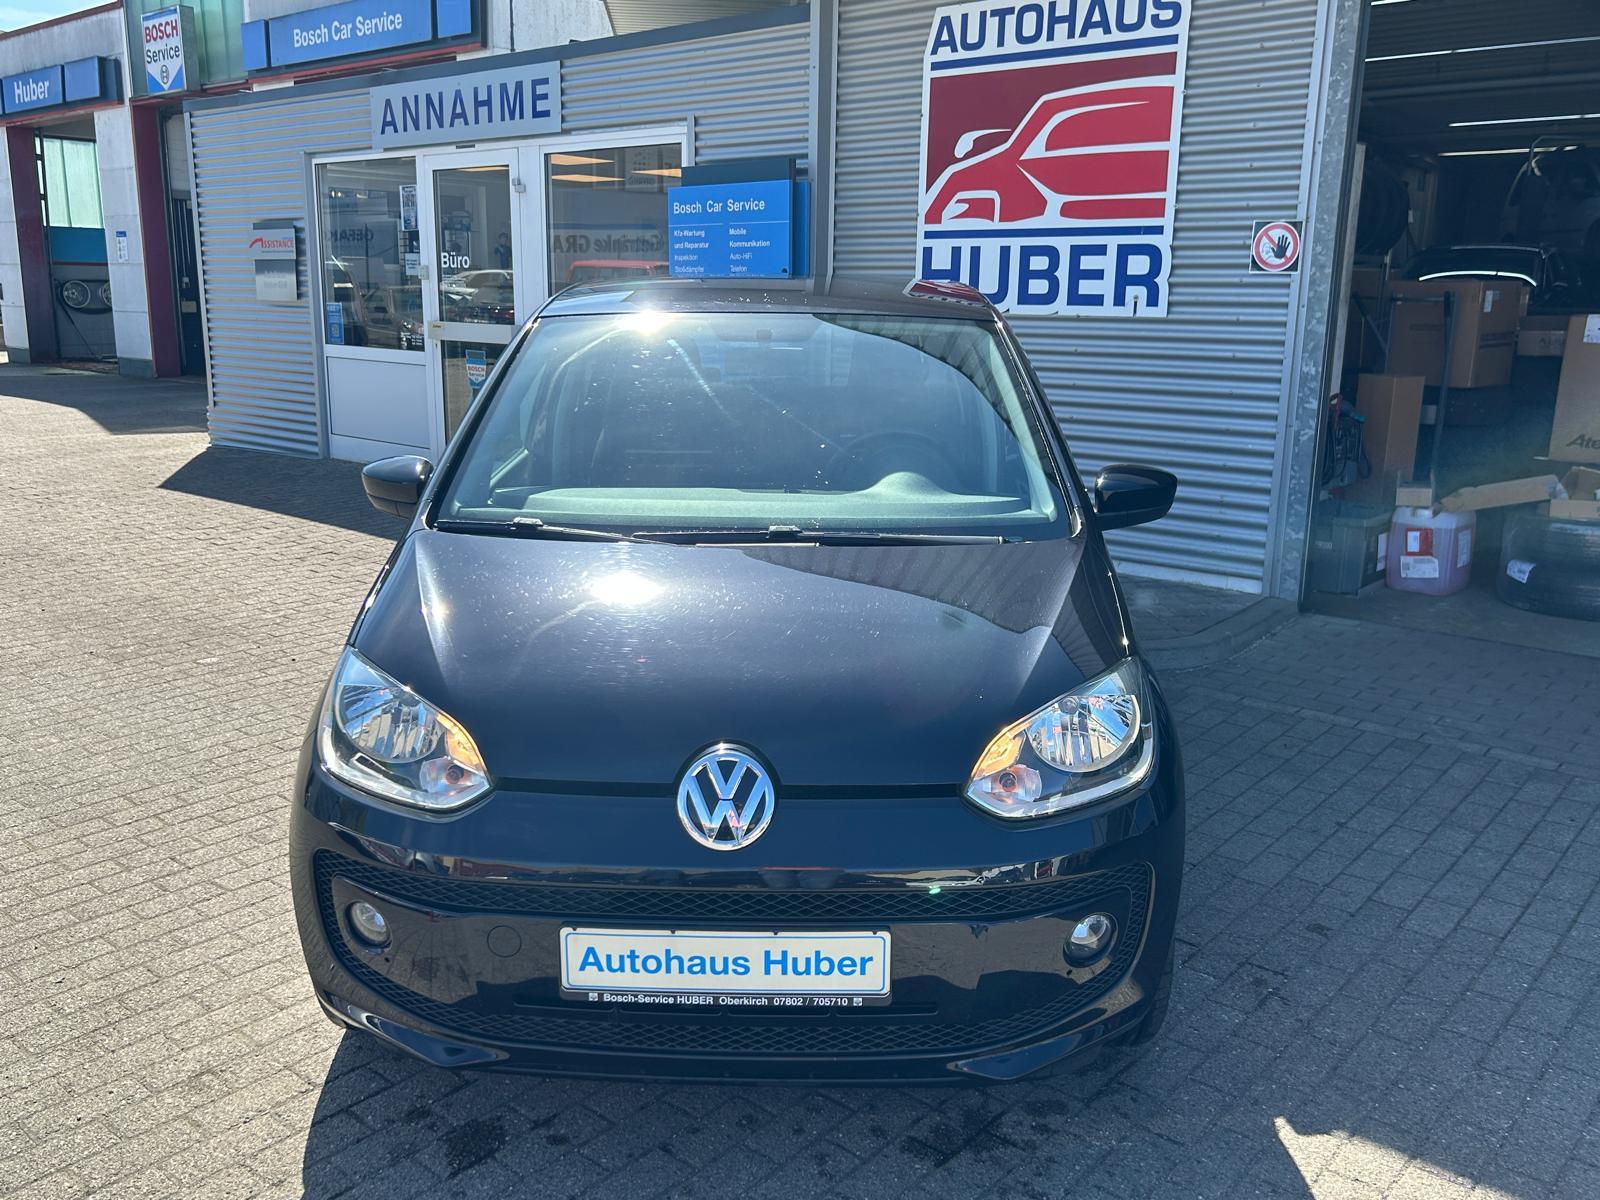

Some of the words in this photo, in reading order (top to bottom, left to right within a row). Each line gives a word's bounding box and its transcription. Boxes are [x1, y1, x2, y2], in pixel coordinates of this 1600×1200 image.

[144, 19, 179, 44] BOSCH
[293, 26, 329, 48] Bosch
[332, 20, 353, 40] Car
[356, 12, 403, 36] Service
[930, 0, 1182, 55] AUTOHAUS
[146, 43, 181, 64] Service
[14, 79, 50, 104] Huber
[380, 77, 552, 135] ANNAHME
[673, 201, 702, 215] Bosch
[706, 200, 723, 213] Car
[727, 198, 765, 212] Service
[673, 229, 705, 238] Kfz-Wartung
[729, 228, 747, 236] Mobile
[684, 242, 709, 250] Reparatur
[729, 240, 770, 248] Kommunikation
[441, 252, 470, 268] Büro
[730, 265, 747, 273] Telefon
[921, 244, 1162, 308] HUBER
[466, 364, 486, 372] BOSCH
[578, 945, 751, 976] Autohaus
[763, 949, 874, 977] Huber
[603, 993, 675, 1005] Bosch-Service
[677, 996, 714, 1006] HUBER
[719, 996, 768, 1007] Oberkirch
[773, 996, 804, 1007] 07802
[813, 997, 848, 1007] 705710
